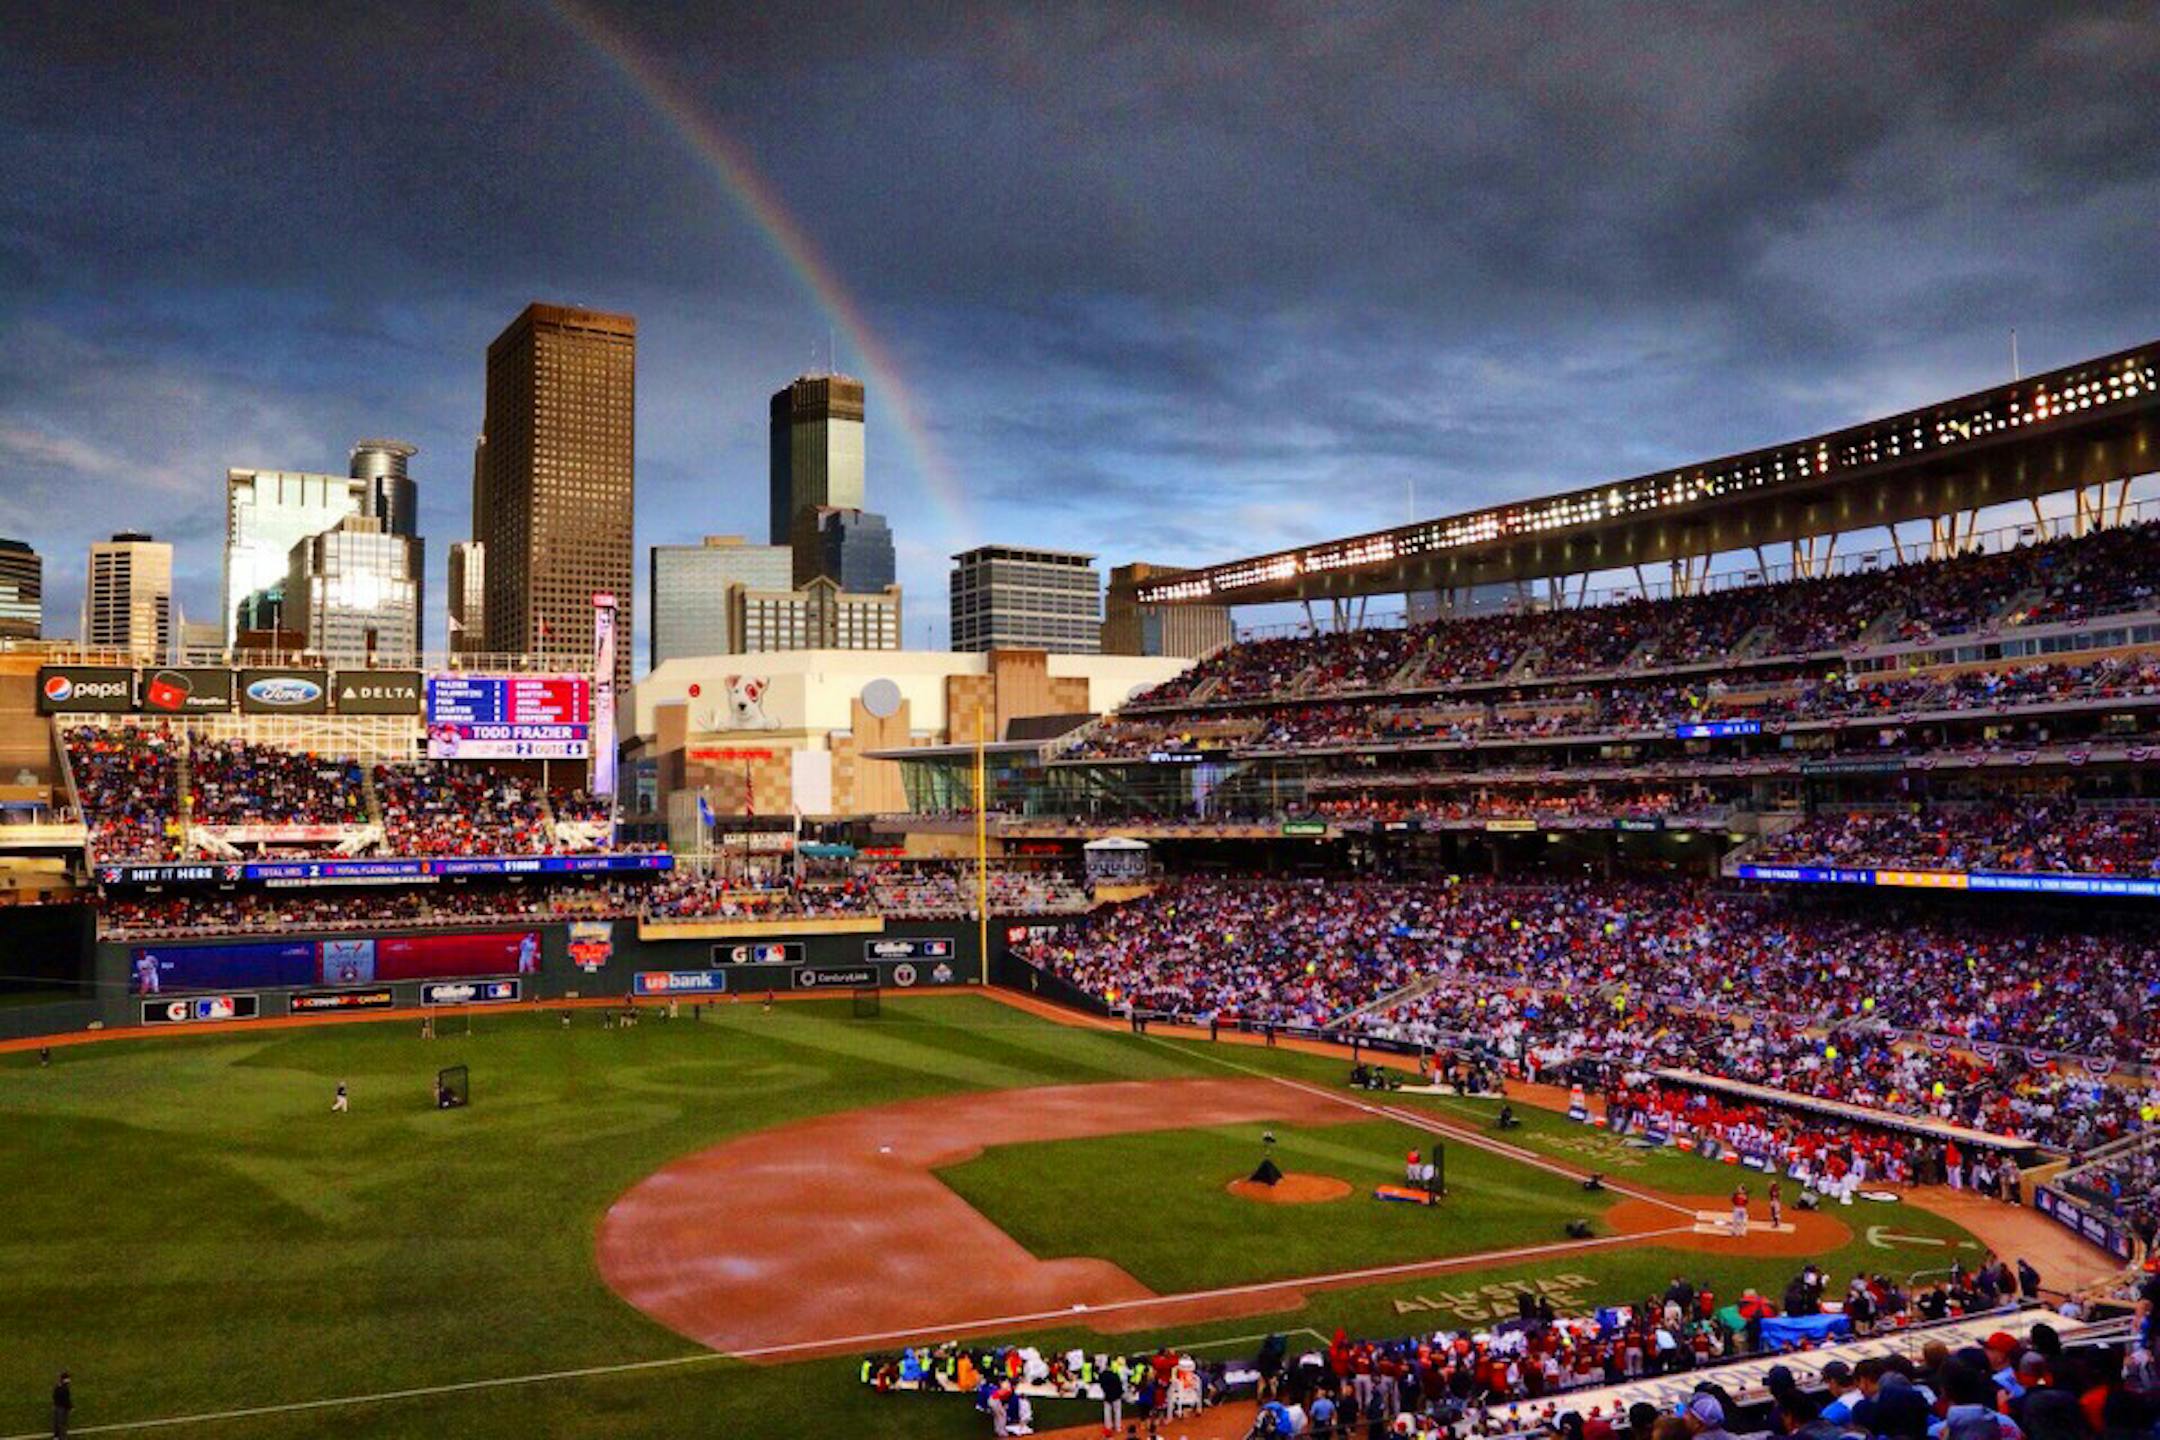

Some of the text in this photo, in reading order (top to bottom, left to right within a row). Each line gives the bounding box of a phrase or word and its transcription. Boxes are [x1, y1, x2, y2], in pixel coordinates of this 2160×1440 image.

[73, 681, 128, 698] pepsi
[261, 684, 307, 701] Ford
[360, 687, 416, 699] DELTA
[472, 726, 573, 739] TODD FRAZIER
[132, 867, 213, 881] HIT IT HERE
[309, 865, 320, 877] 2
